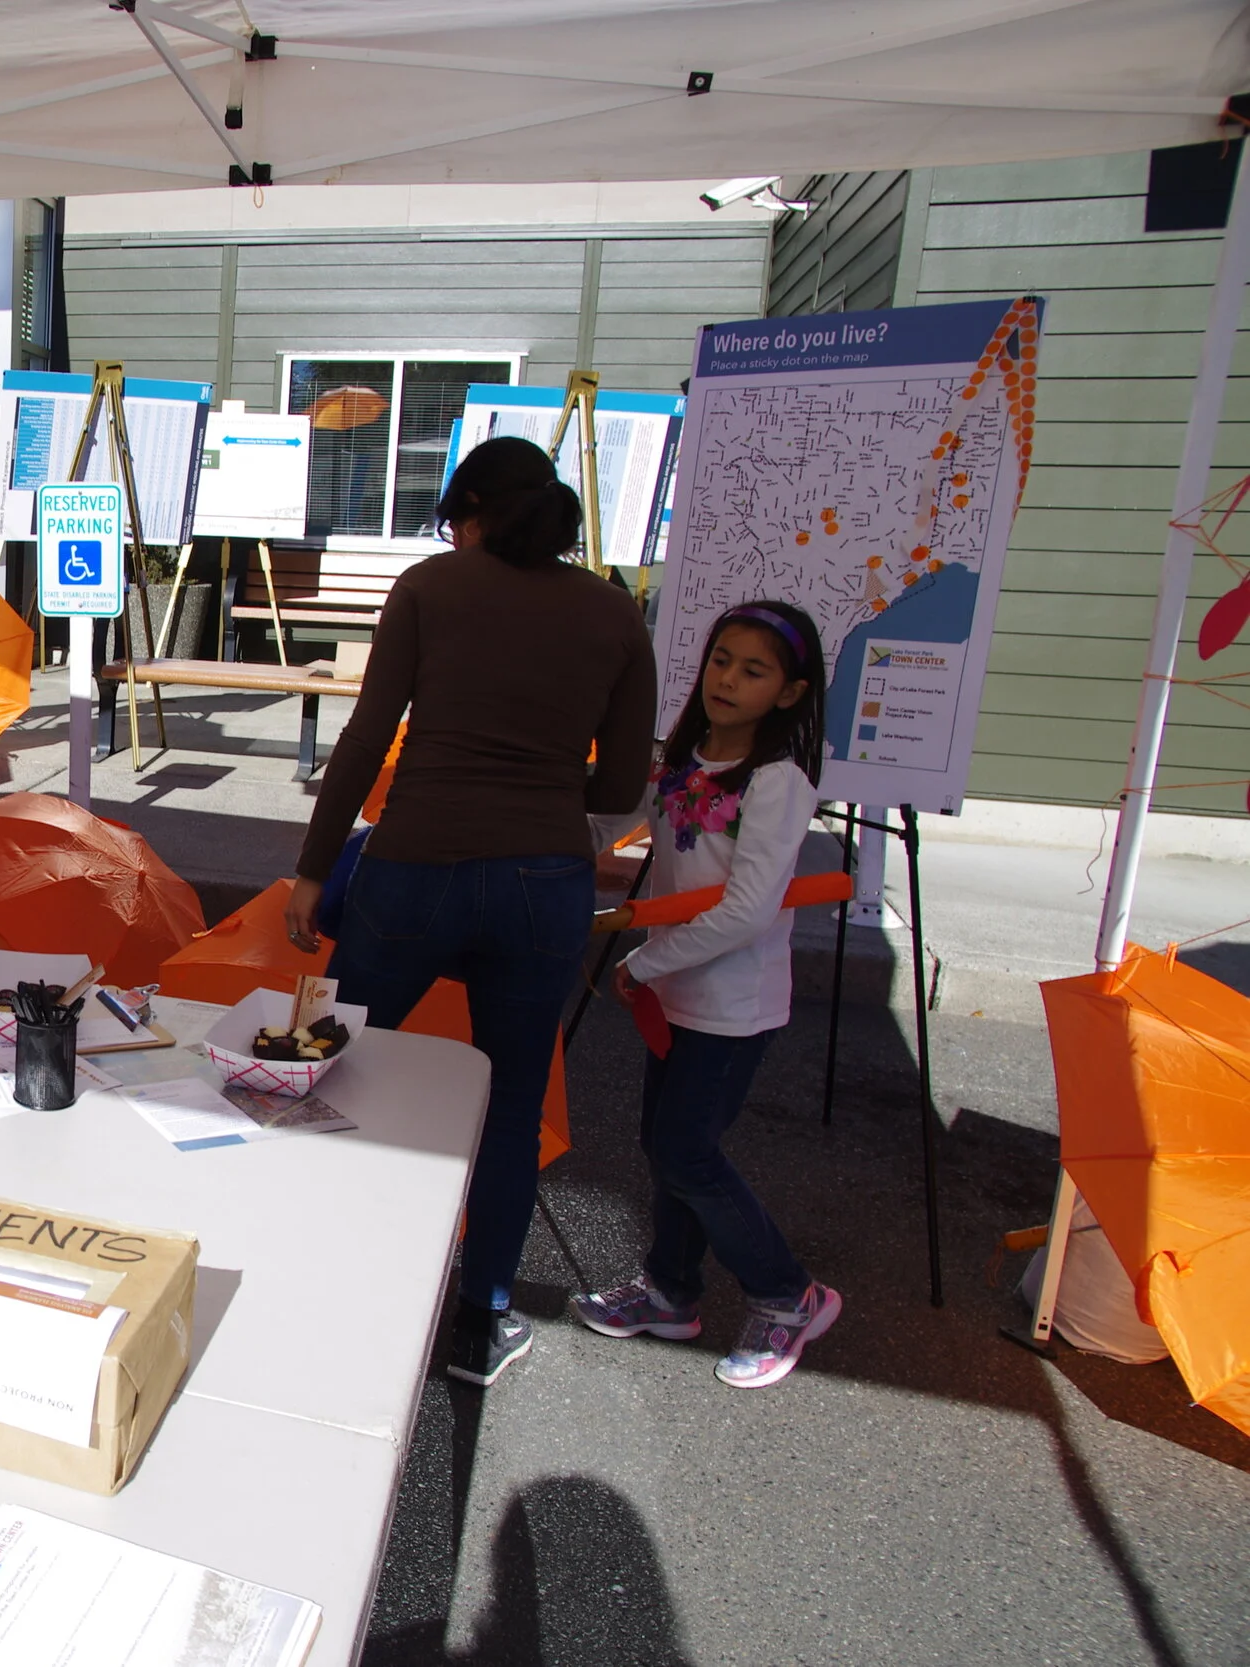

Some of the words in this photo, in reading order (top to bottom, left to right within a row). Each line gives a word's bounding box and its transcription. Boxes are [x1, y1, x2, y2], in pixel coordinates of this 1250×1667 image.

[713, 333, 769, 353] Where
[774, 329, 796, 349] do
[801, 331, 835, 352] you
[841, 322, 889, 345] live?
[710, 360, 738, 371] Place
[740, 361, 747, 369] a
[749, 356, 779, 370] sticky
[781, 355, 800, 366] dot
[803, 356, 818, 365] on
[821, 352, 839, 364] the
[842, 353, 869, 364] map
[43, 495, 116, 511] RESERVED
[47, 518, 113, 535] PARKING
[93, 591, 116, 599] PARKING
[891, 655, 913, 663] TOWN
[914, 656, 945, 665] CENTER
[46, 1396, 73, 1412] NON
[2, 1518, 24, 1543] CENTER
